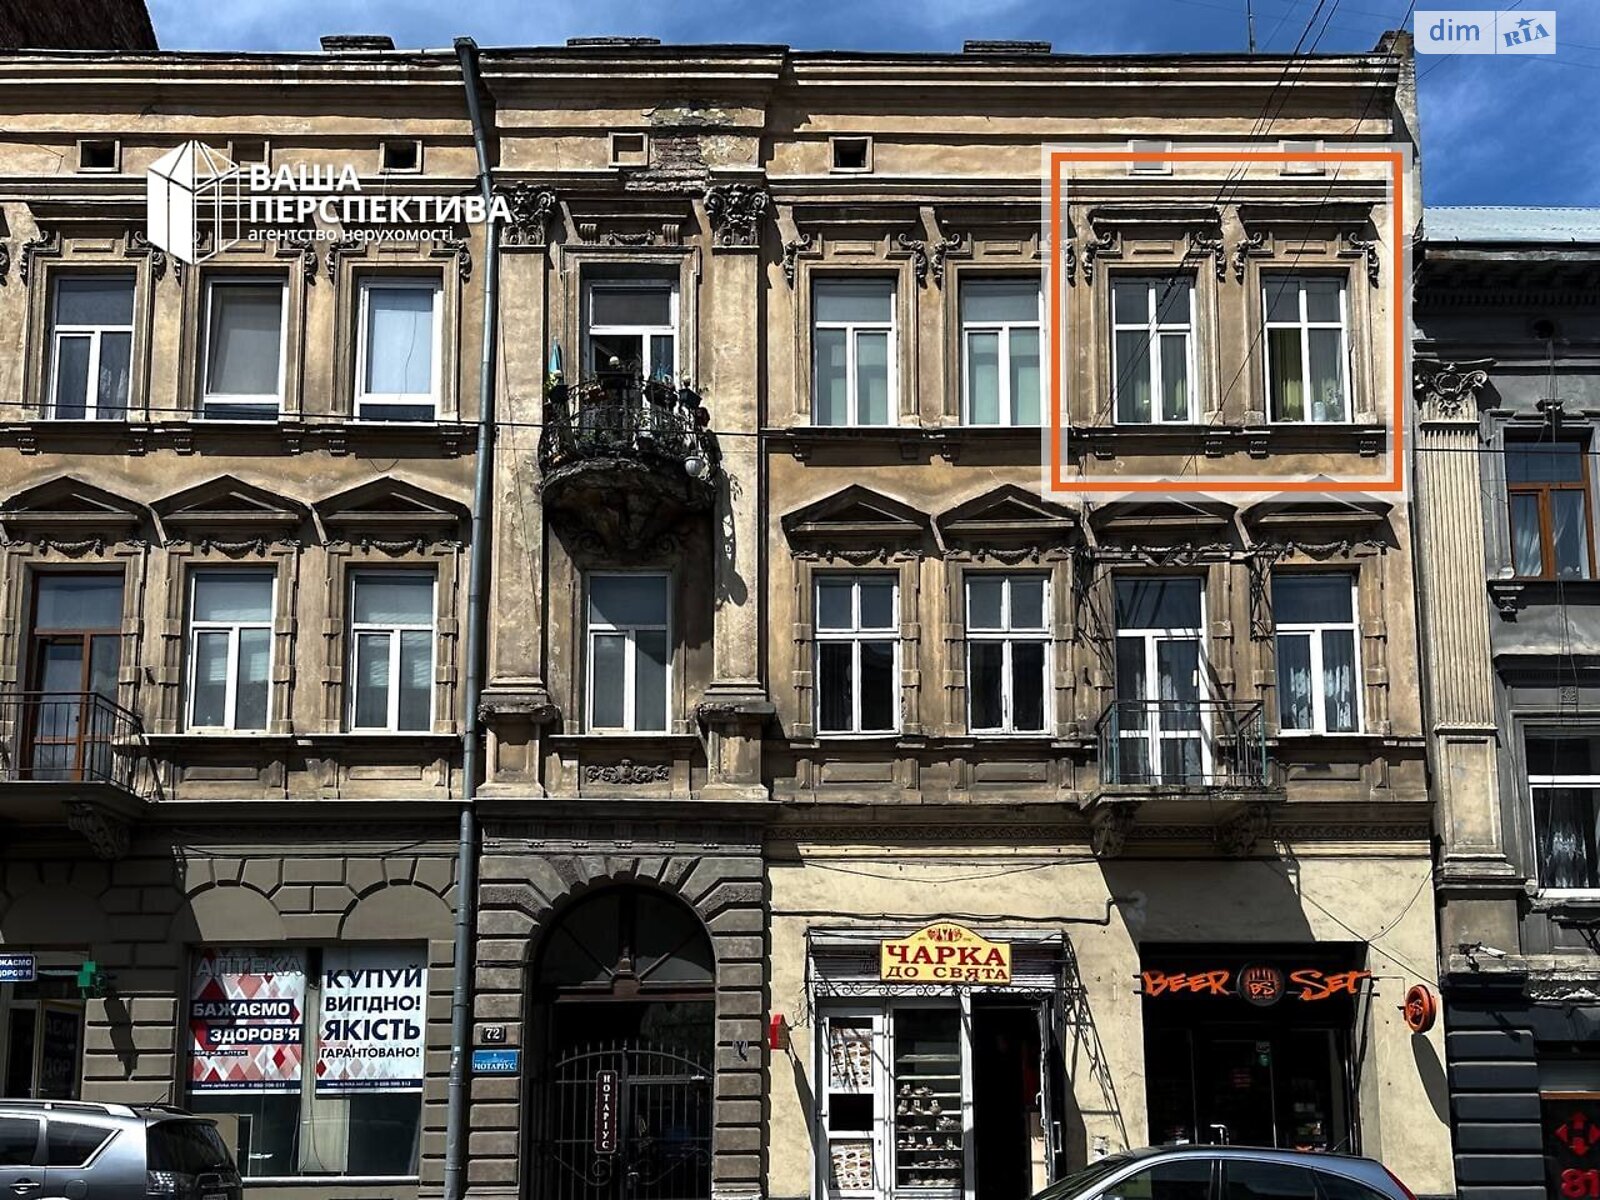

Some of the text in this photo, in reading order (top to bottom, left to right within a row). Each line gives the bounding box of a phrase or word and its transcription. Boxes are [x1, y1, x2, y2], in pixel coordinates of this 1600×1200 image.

[885, 944, 1007, 967] ЧАРКА
[195, 956, 303, 977] АПТЕКА
[326, 964, 422, 989] КУПУЙ
[886, 965, 1008, 980] ДО СВЯТА
[1142, 969, 1231, 997] BEER
[193, 1002, 291, 1017] БАЖАЄМО
[325, 995, 421, 1014] ВИГІДНО!
[209, 1027, 300, 1044] ЗДОРОВ'Я
[323, 1018, 421, 1041] ЯКІСТЬ
[485, 1028, 501, 1040] 72
[320, 1046, 420, 1058] ГАРАНТОВАНО!
[602, 1074, 611, 1149] НОТАРІУС
